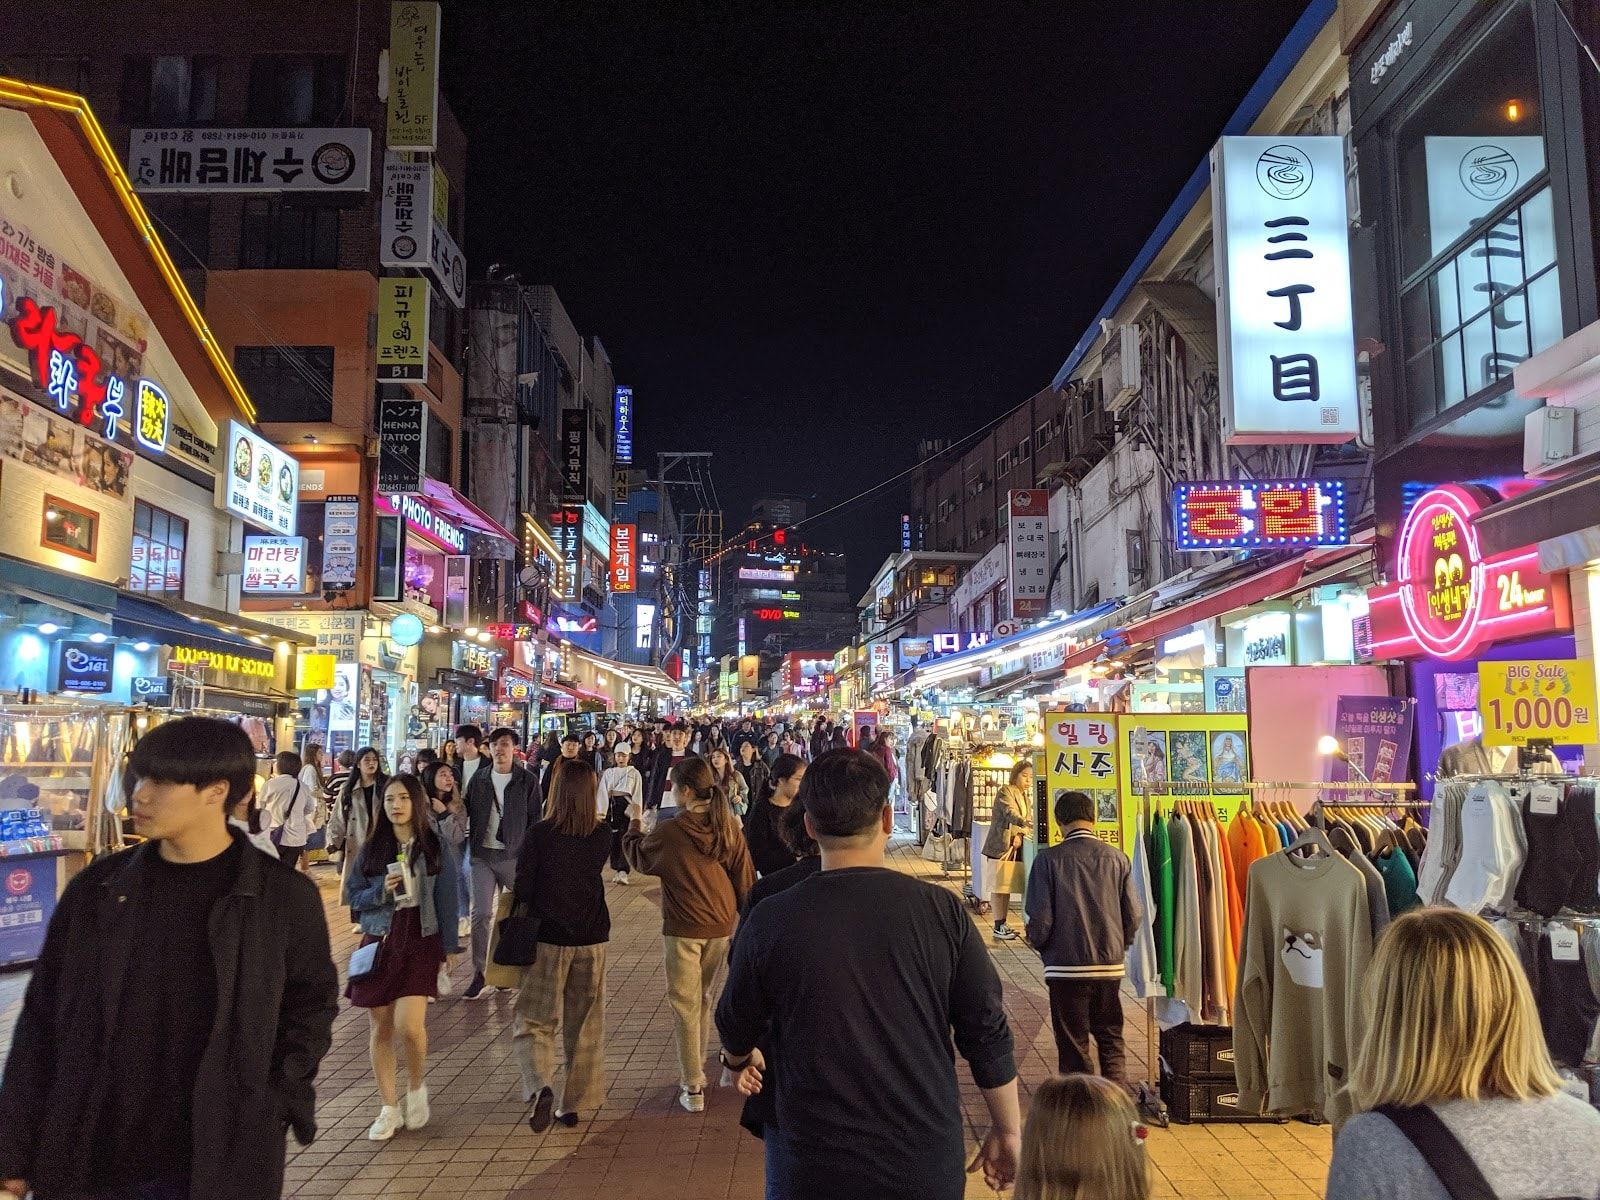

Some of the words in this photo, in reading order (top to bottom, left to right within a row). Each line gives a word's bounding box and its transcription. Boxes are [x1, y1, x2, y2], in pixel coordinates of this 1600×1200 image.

[414, 114, 428, 125] 5F
[159, 147, 305, 185] 수제담배
[393, 181, 415, 233] 수제담배
[33, 262, 54, 290] 커플
[1264, 216, 1320, 402] 三丁目
[380, 345, 421, 360] 프렌즈
[391, 365, 409, 378] B1
[385, 405, 420, 417] ヘンナ
[619, 396, 630, 433] 더하우스
[382, 433, 420, 441] TATTOO
[383, 421, 420, 430] HENNA
[568, 431, 581, 485] 핑거뮤직
[402, 494, 432, 530] PHOTO
[434, 516, 465, 551] FRIENDS
[1187, 487, 1332, 536] 궁합
[1431, 511, 1455, 531] 인생샷
[1017, 533, 1045, 542] 순대국
[247, 547, 300, 562] 마라탕
[564, 526, 578, 598] 도쿄스테이크
[615, 527, 631, 583] 보드게임
[245, 573, 298, 589] 쌀국수
[614, 583, 632, 591] Cafe
[1496, 570, 1524, 611] 24
[1523, 588, 1545, 605] hour
[760, 608, 783, 620] DVD
[176, 645, 198, 665] too
[225, 654, 240, 673] for
[241, 657, 275, 678] school
[1507, 665, 1531, 678] BIG
[1534, 663, 1565, 678] Sale
[1057, 722, 1108, 746] 힐링
[1053, 751, 1113, 778] 사주
